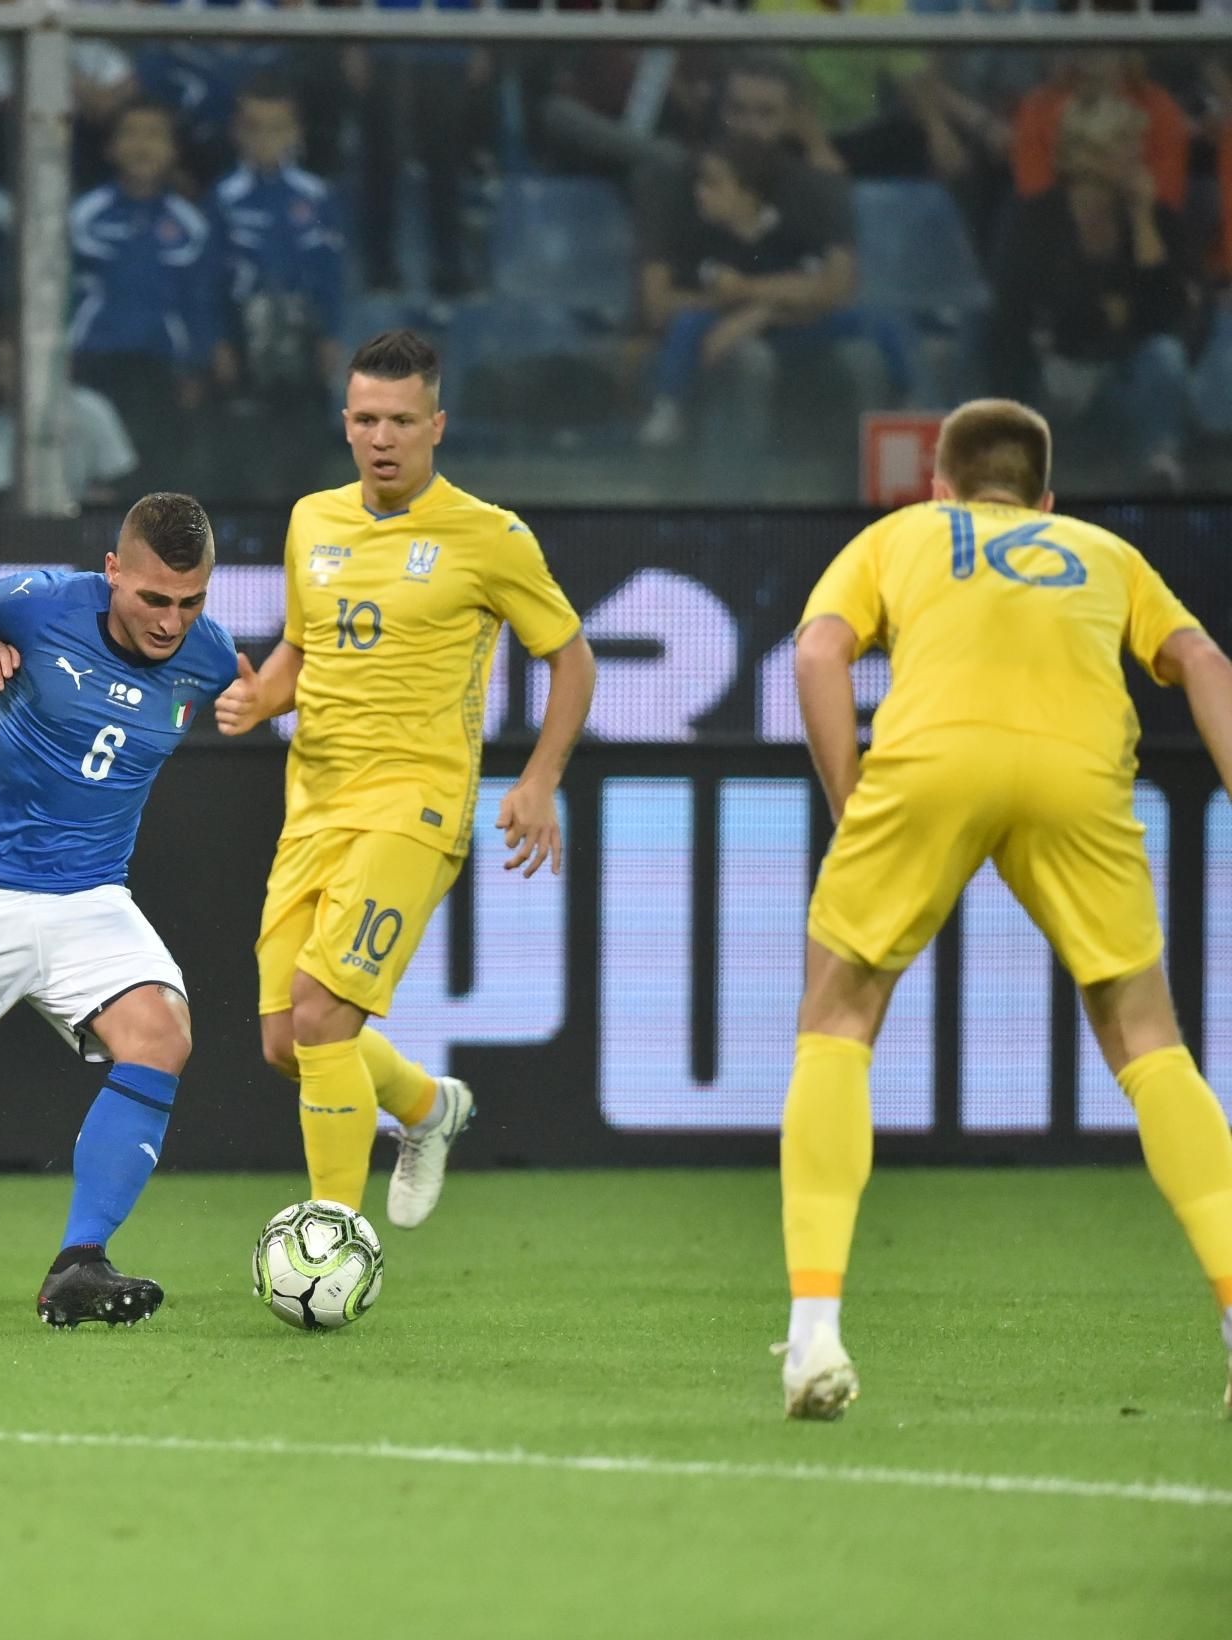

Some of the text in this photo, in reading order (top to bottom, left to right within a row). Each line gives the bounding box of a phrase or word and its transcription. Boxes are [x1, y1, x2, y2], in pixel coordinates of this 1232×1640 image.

[936, 505, 1087, 588] 16
[336, 598, 383, 650] 10
[80, 724, 127, 781] 6
[352, 898, 403, 962] 10
